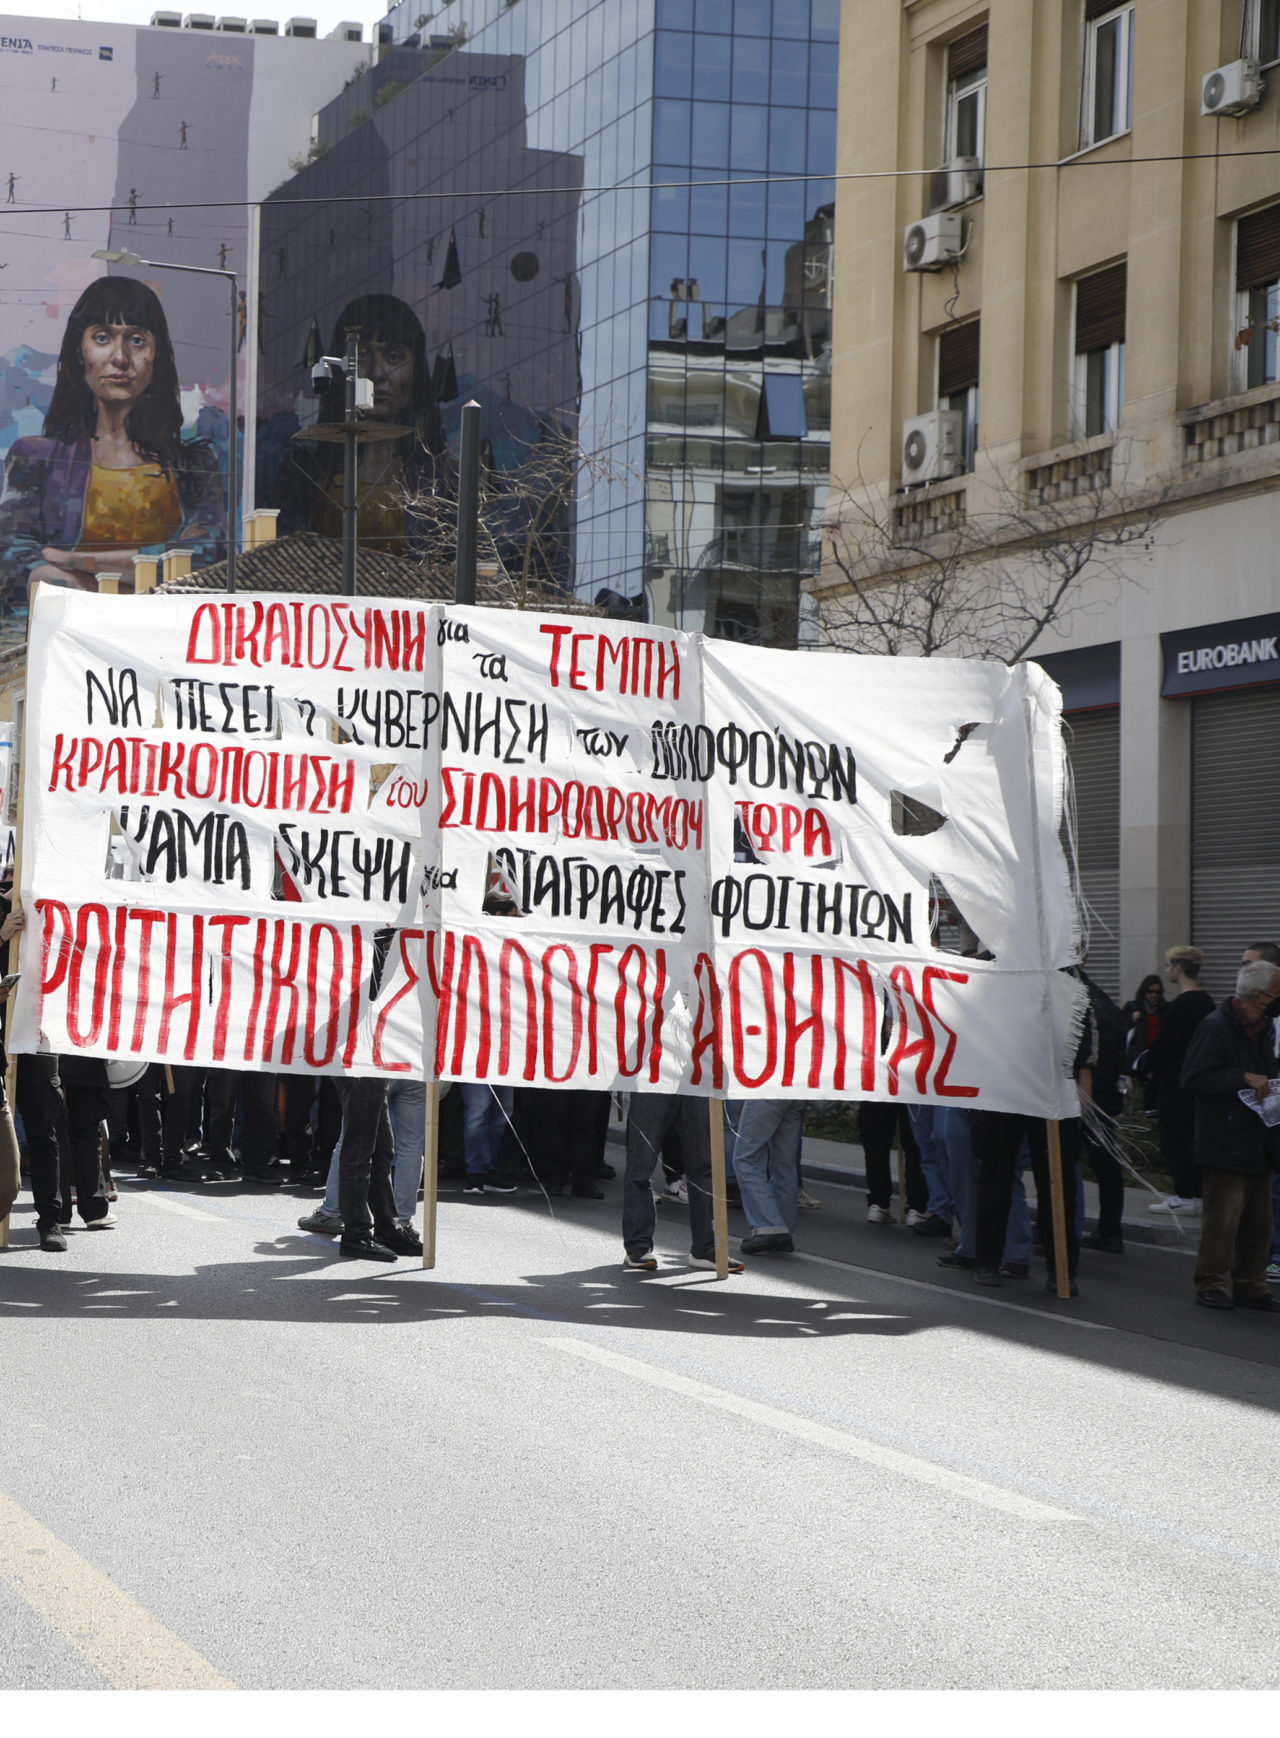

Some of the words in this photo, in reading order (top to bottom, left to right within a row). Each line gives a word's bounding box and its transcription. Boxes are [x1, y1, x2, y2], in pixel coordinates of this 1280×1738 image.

[186, 601, 426, 671] ΔΙΚΑΙΟΣΥΝΗ
[437, 619, 469, 646] για
[472, 653, 508, 682] τα
[540, 624, 681, 700] ΤΕΜΠΗ
[1177, 636, 1279, 674] EUROBANK
[86, 667, 142, 728] ΝΑ
[169, 678, 275, 733] ΠΕΣΕΙ
[337, 686, 548, 764] ΚΥΒΕΡΝΗΣΗ
[577, 727, 629, 757] των
[48, 732, 356, 814] ΚΡΑΤΙΚΟΠΟΙΗΣΗ
[438, 767, 704, 851] ΣΙΔΗΡΟΔΡΟΜΟΥ
[734, 800, 833, 858] ΤΩΡΑ
[711, 873, 914, 945] ΦΟΙΤΗΤΩΝ
[372, 928, 667, 1084] ΣΥΛΛΟΓΟΙ
[690, 947, 981, 1099] ΑΘΗΝΑΣ
